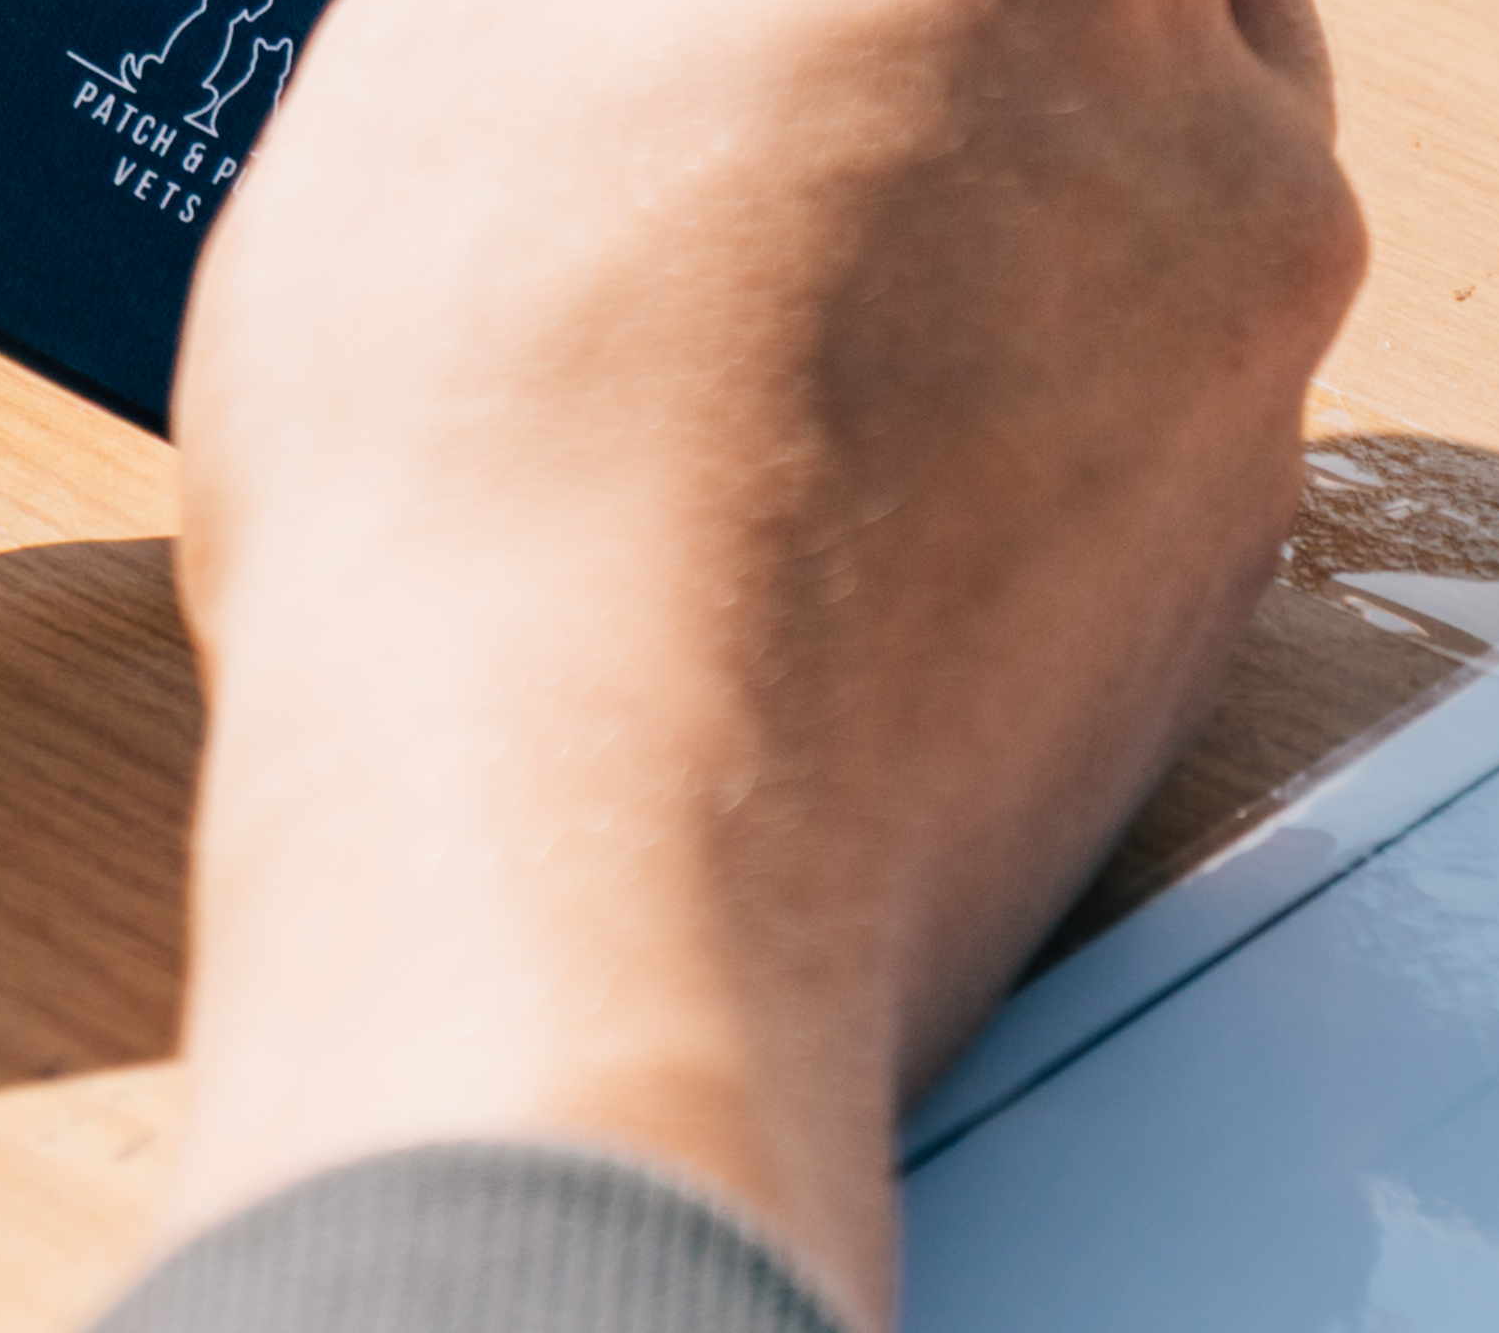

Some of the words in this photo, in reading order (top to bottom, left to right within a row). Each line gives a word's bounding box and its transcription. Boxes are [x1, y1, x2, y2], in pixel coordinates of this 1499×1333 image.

[73, 81, 178, 157] PATCH
[182, 142, 207, 174] &
[114, 156, 202, 223] VETS
